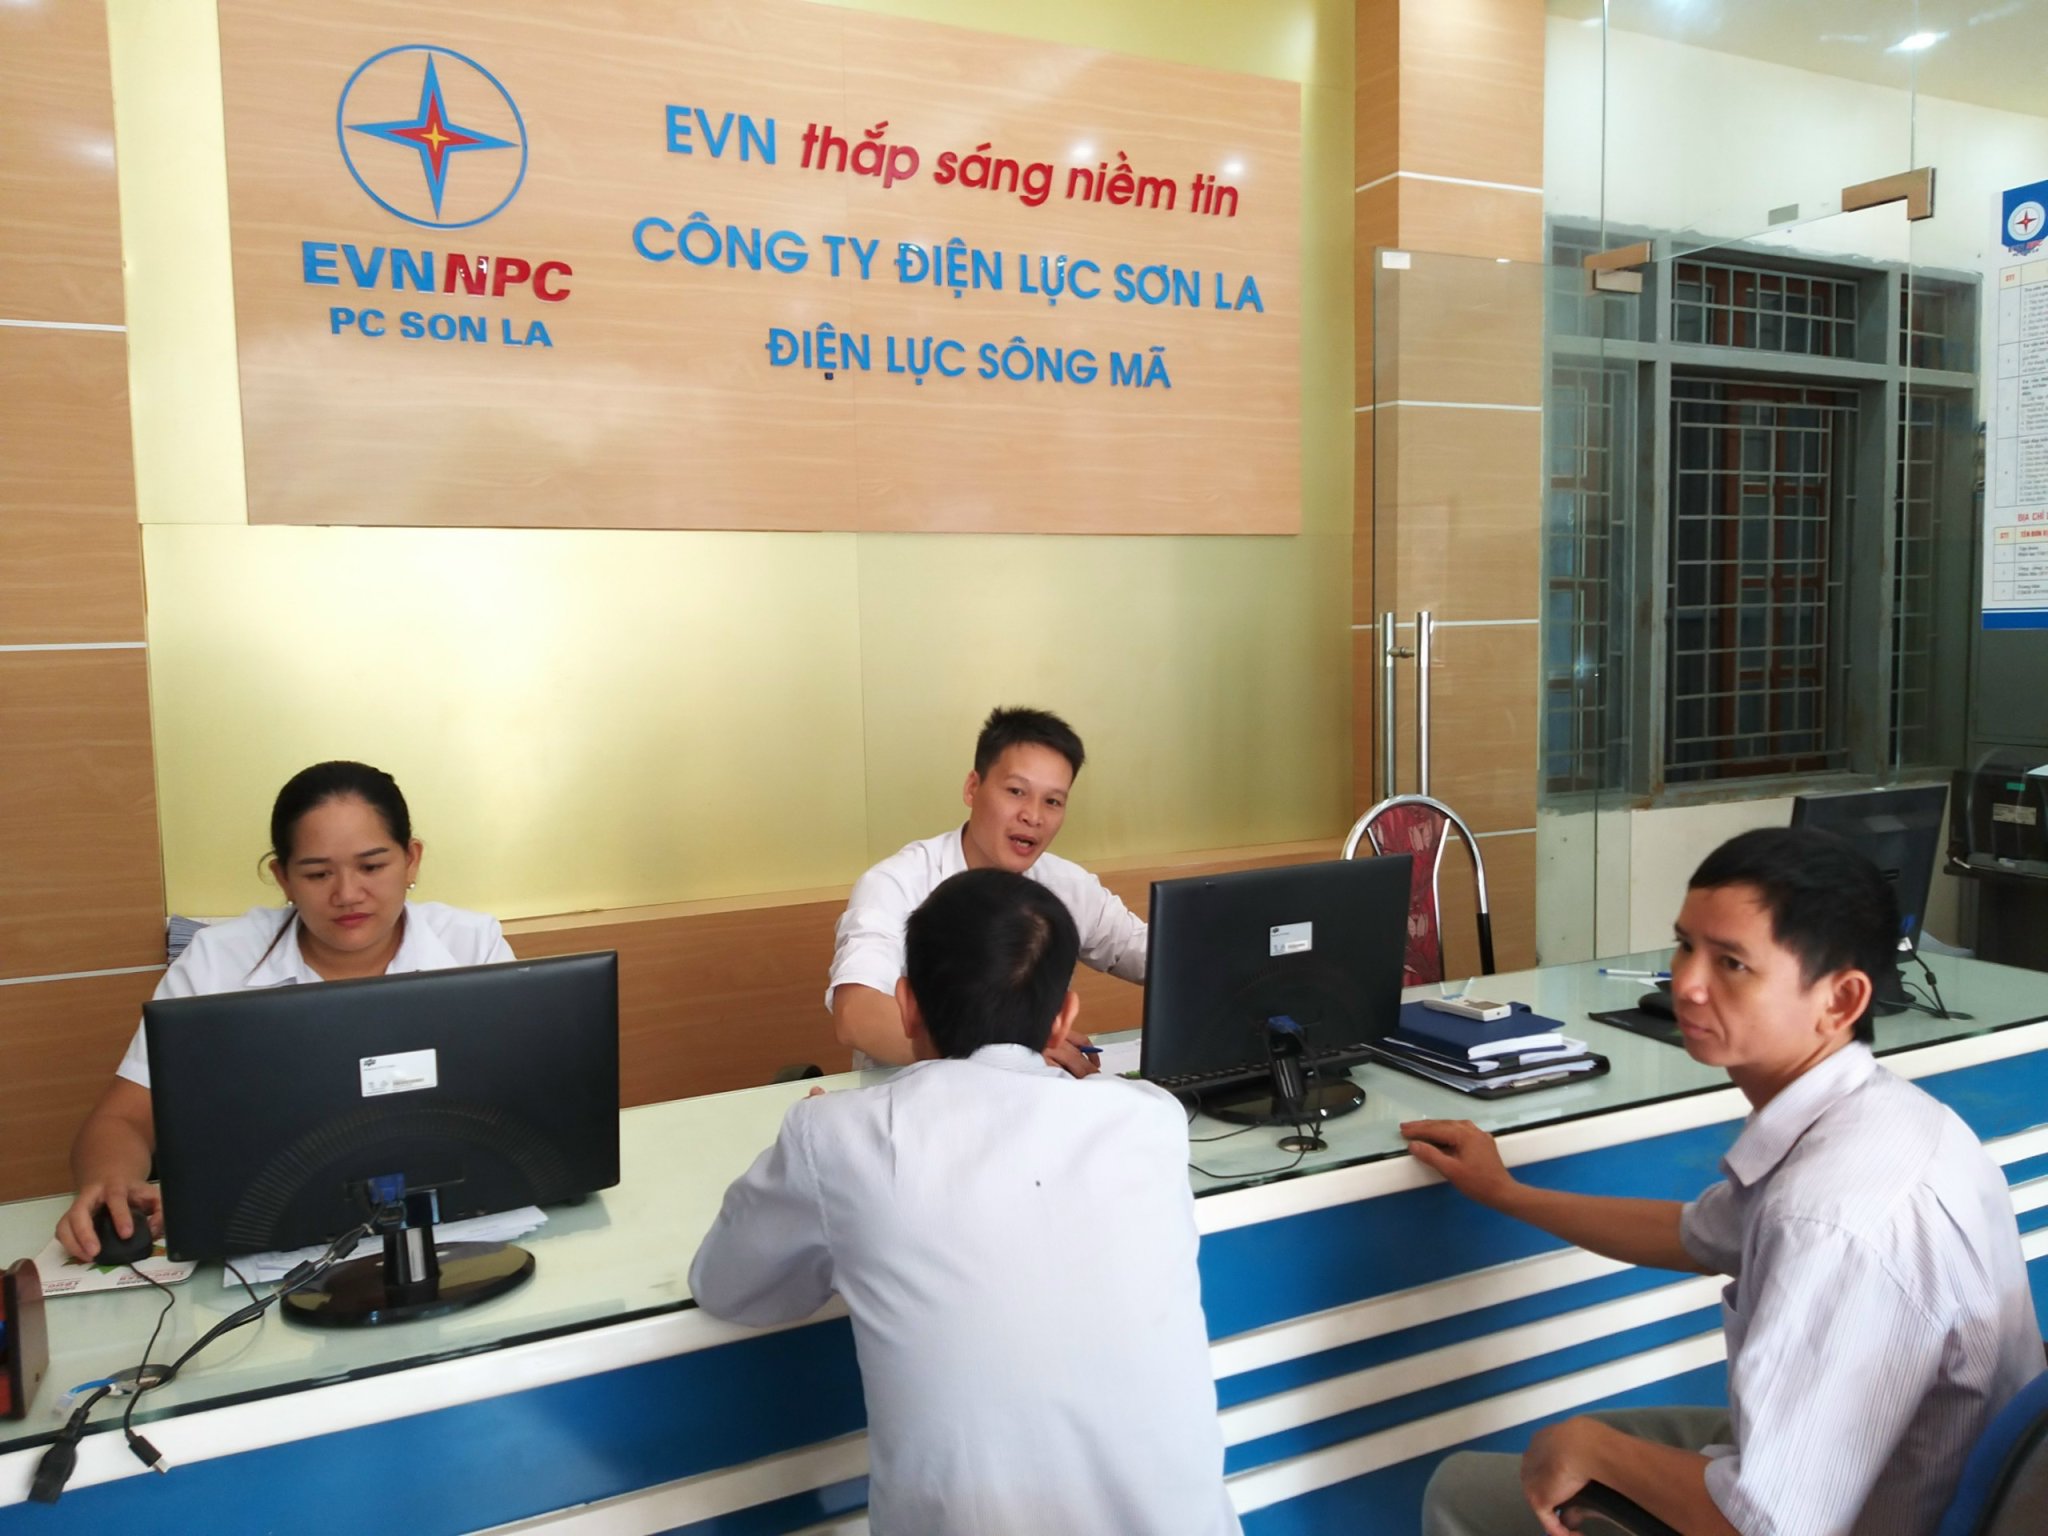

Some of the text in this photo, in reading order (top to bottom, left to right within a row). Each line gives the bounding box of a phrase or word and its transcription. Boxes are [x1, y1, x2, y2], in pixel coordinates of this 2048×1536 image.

[662, 104, 1240, 217] EVN thắp sáng niềm tin
[302, 241, 574, 302] EVNNPC
[632, 210, 1265, 313] CÔNG TY ĐIỆN LỰC SƠN LA
[330, 307, 553, 348] PC SON LA
[765, 322, 1173, 389] ĐIỆN LỰC SÔNG MÃ
